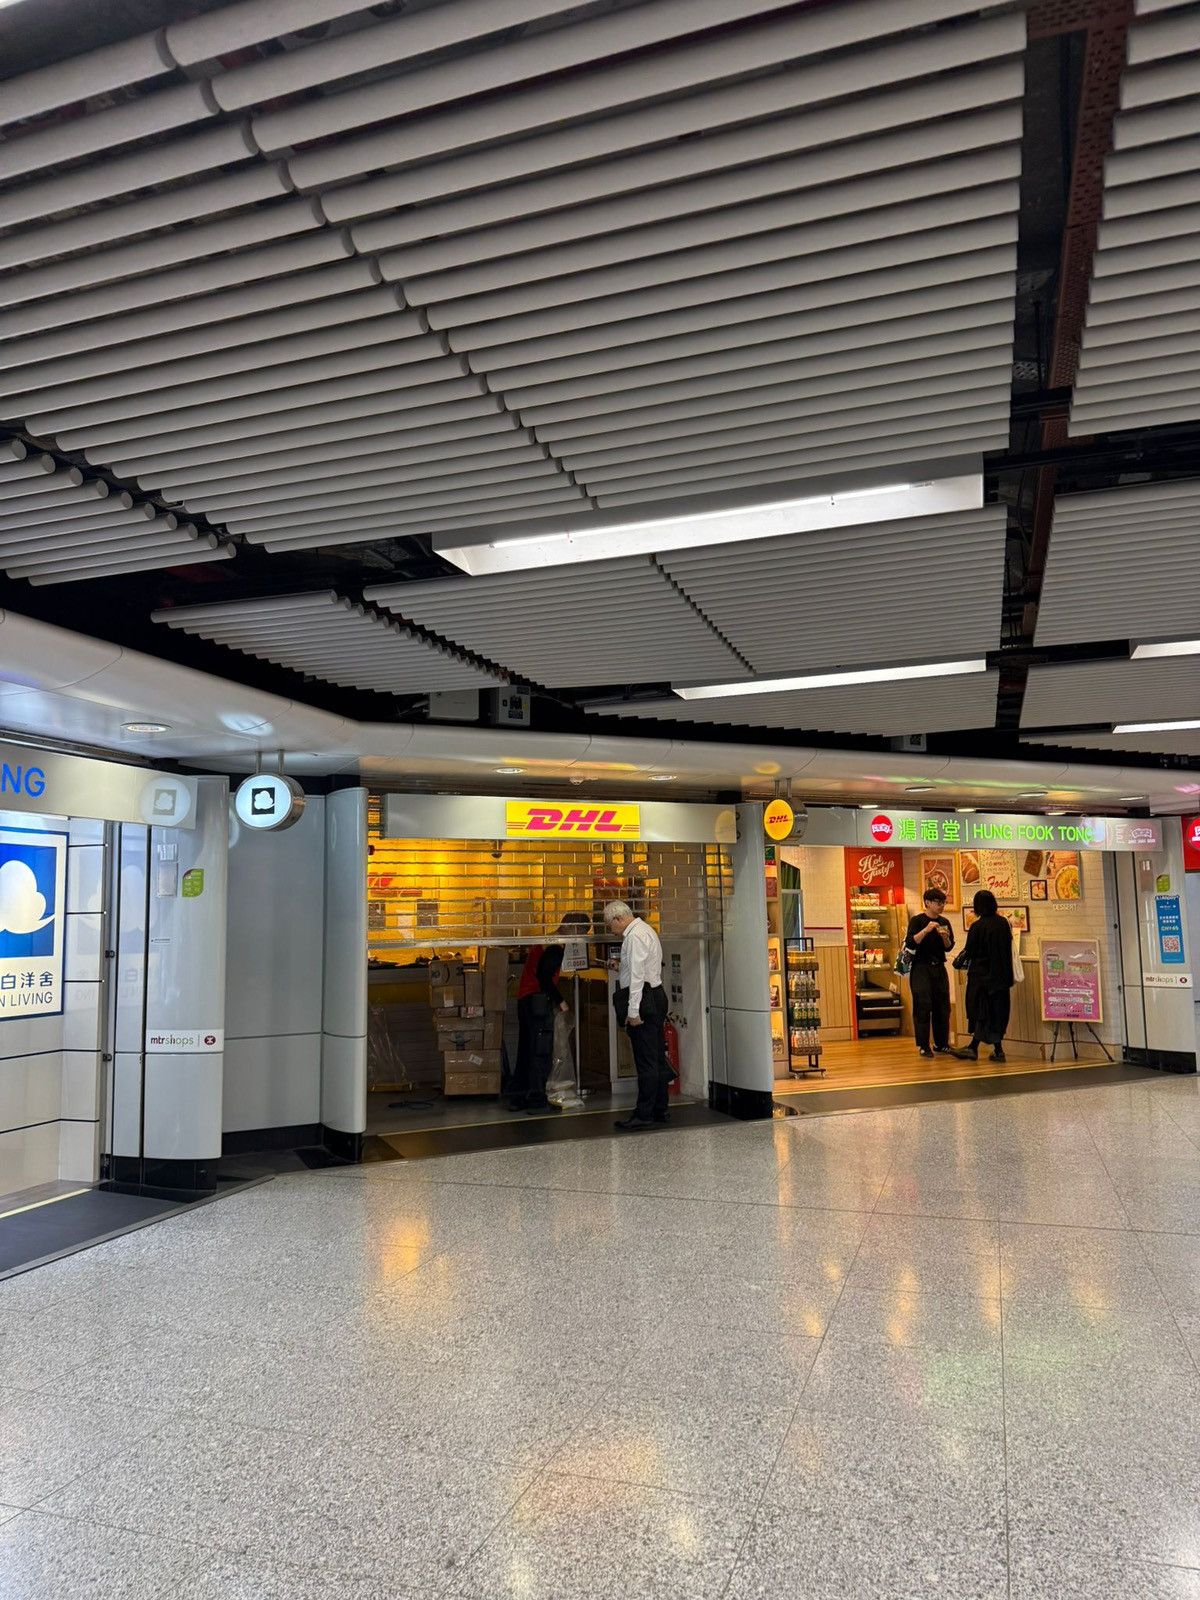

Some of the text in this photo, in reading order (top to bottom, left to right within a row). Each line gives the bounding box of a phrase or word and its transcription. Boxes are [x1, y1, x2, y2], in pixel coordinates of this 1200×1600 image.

[2, 763, 46, 798] NG
[526, 808, 622, 832] DHL
[768, 815, 789, 824] DHL
[898, 819, 960, 841] 鴻福堂
[973, 823, 1012, 840] HUNG
[1018, 826, 1054, 841] FOOK
[987, 875, 1010, 891] Food
[1, 971, 54, 989] 白洋舍
[10, 992, 53, 1007] LIVING
[150, 1035, 194, 1047] mtrshops
